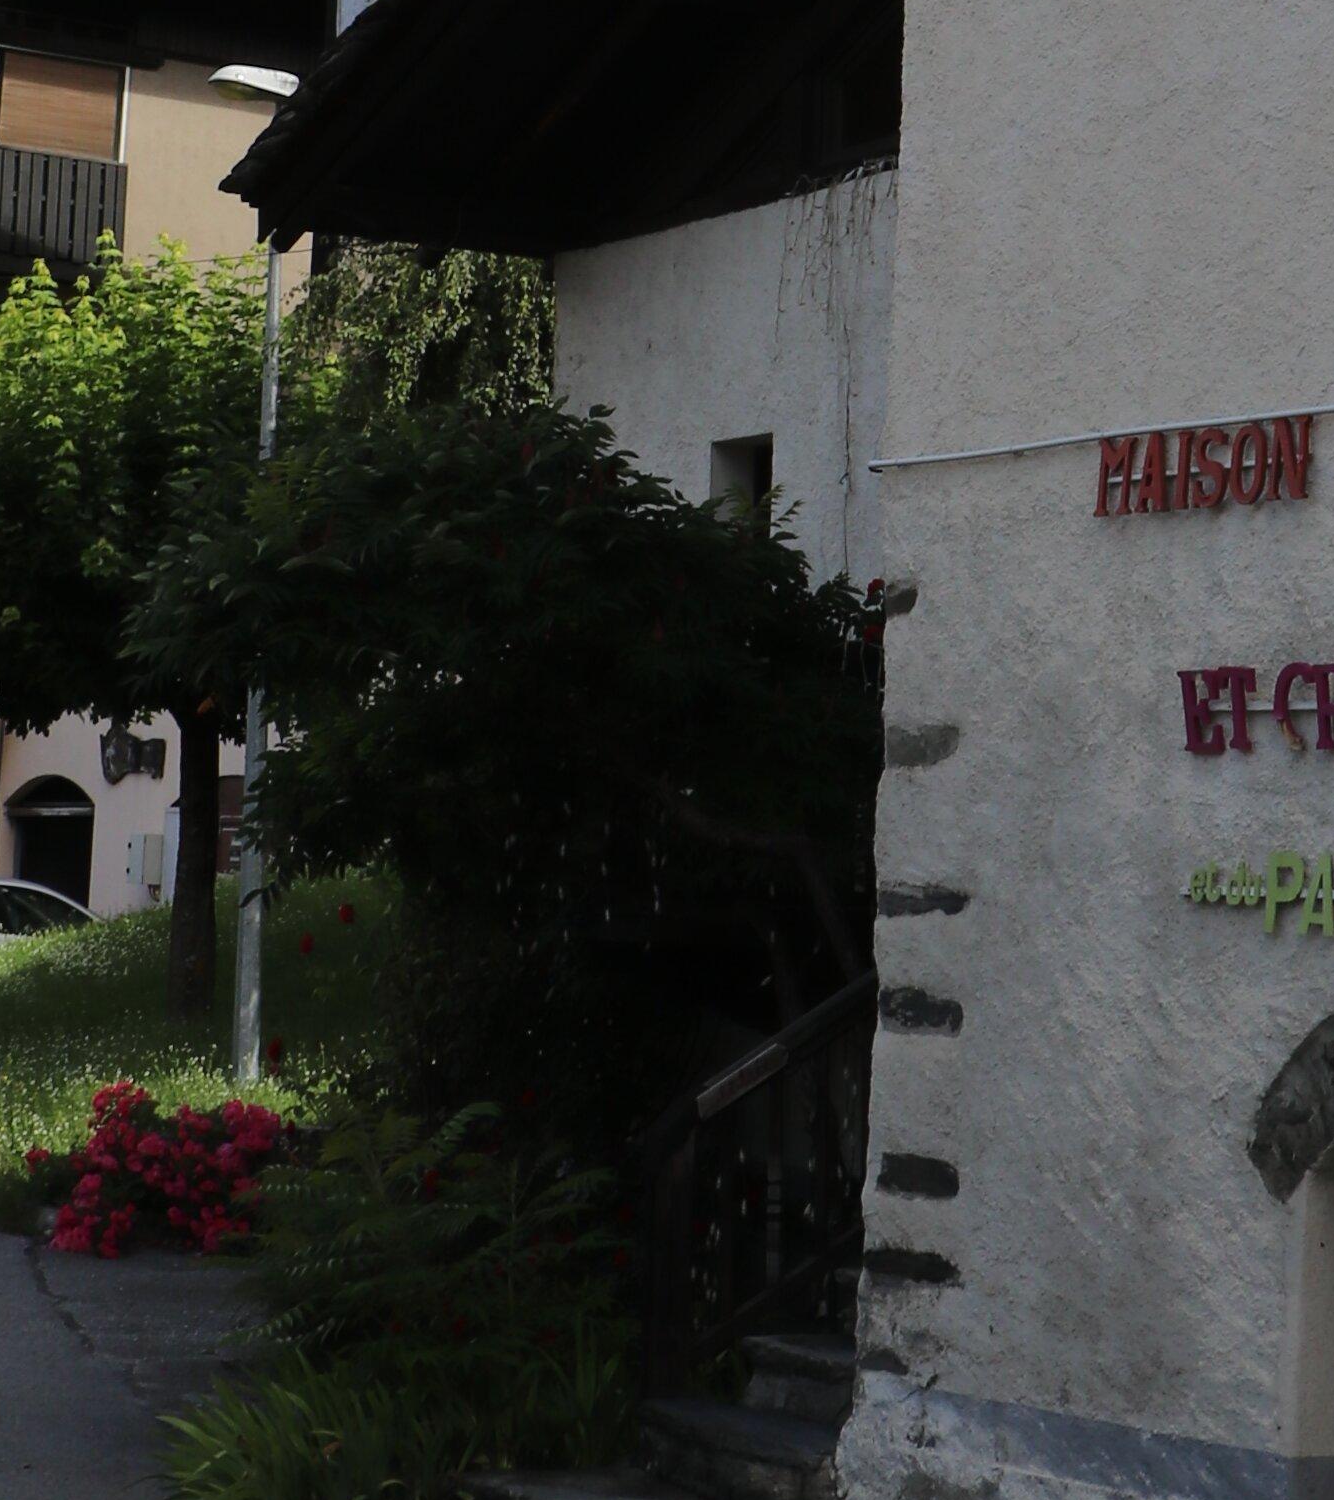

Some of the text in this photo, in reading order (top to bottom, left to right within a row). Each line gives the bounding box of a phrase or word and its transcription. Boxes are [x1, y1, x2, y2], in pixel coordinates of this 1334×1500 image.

[1093, 414, 1314, 518] MAISON
[1177, 666, 1257, 755] ET
[1188, 859, 1222, 902] et
[1225, 859, 1263, 907] du
